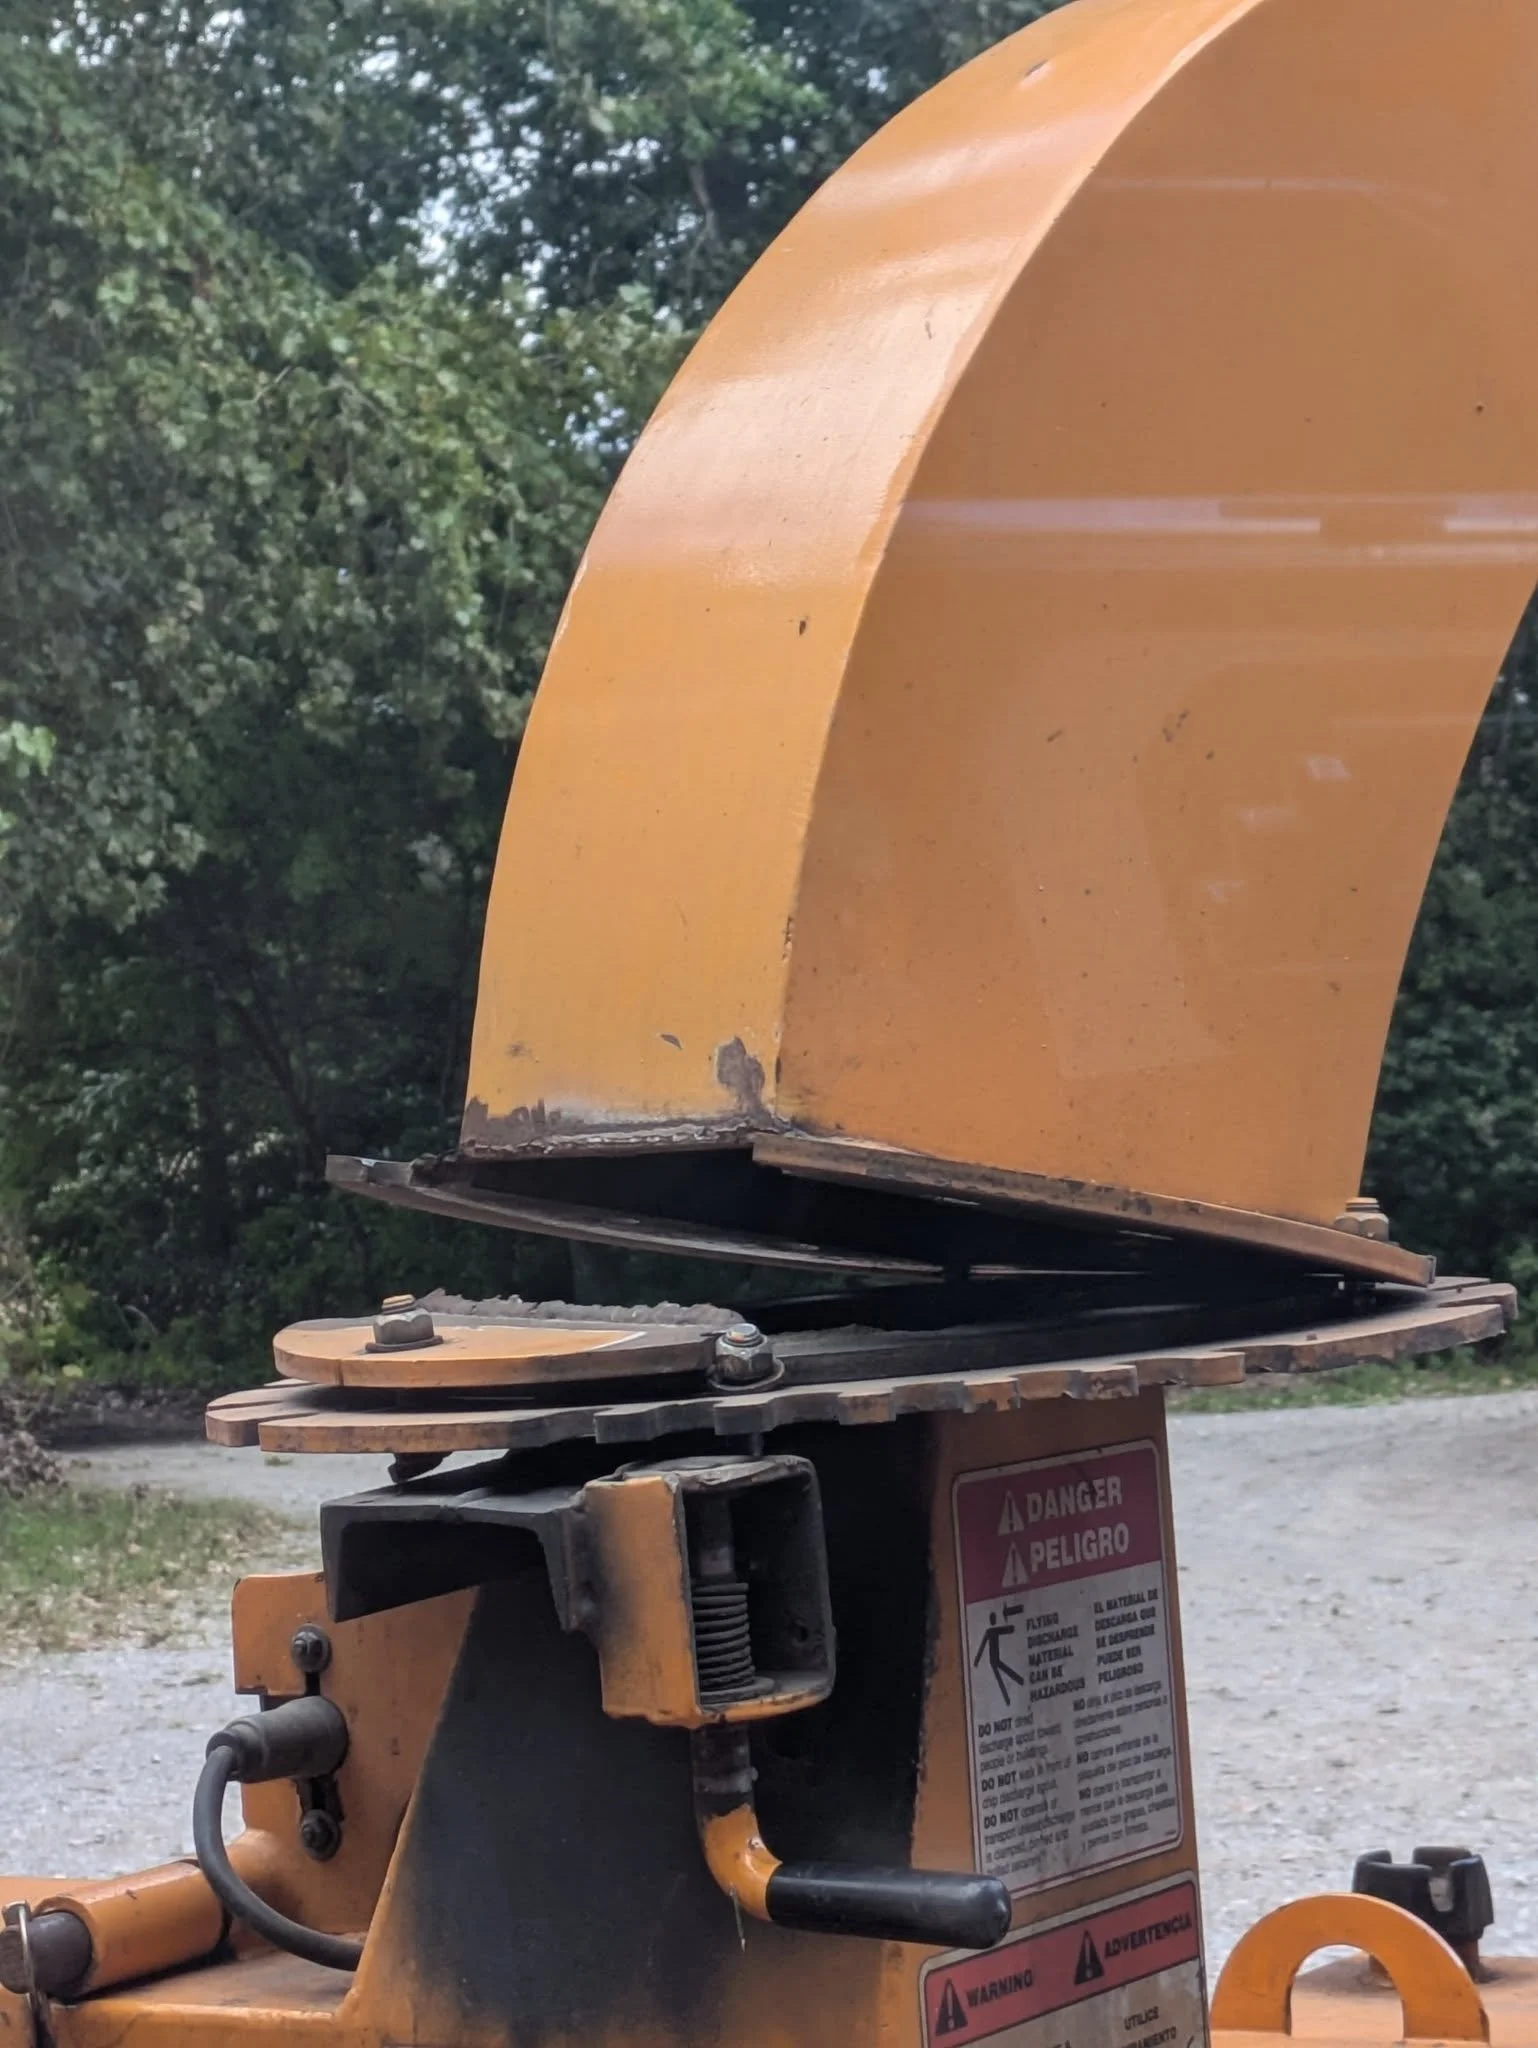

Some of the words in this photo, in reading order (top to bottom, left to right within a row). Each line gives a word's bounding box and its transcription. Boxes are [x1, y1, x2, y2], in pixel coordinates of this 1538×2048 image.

[1026, 1476, 1122, 1523] DANGER
[1030, 1523, 1129, 1573] PELIGRO
[1026, 1612, 1059, 1631] FLYING
[1028, 1645, 1074, 1667] MATERIAL
[1029, 1668, 1048, 1685] CAN
[978, 1723, 991, 1738] DO
[993, 1717, 1012, 1734] NOT
[981, 1777, 994, 1792] DO
[998, 1770, 1016, 1788] NOT
[984, 1814, 996, 1829] DO
[1000, 1807, 1019, 1824] NOT
[1104, 1912, 1192, 1959] ADVERTENCIA
[966, 1968, 1033, 2008] WARNING
[1124, 2006, 1159, 2031] UTILICE
